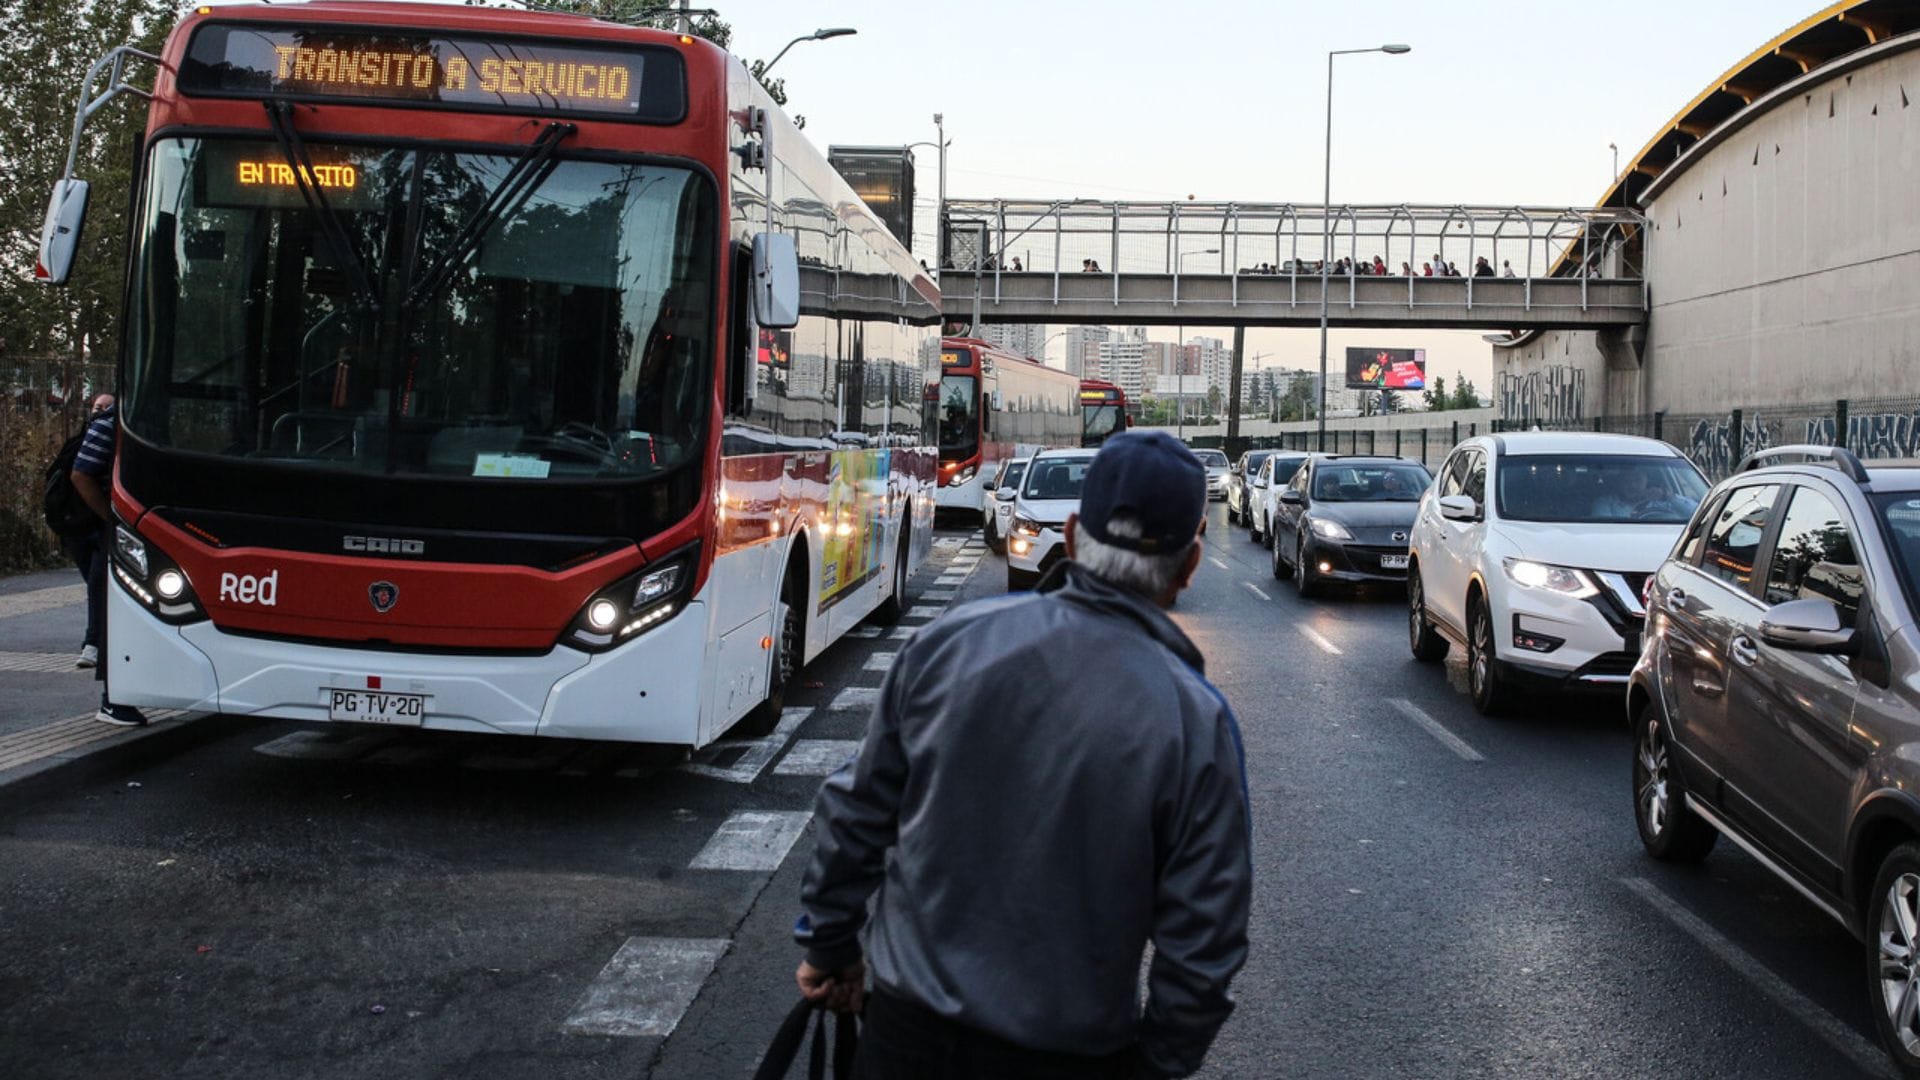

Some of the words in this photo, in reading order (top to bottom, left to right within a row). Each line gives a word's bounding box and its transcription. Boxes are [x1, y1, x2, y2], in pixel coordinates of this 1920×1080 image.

[275, 46, 434, 88] TRANSITO
[446, 57, 467, 90] A
[480, 59, 628, 99] SERVICIO
[240, 162, 263, 183] EN
[220, 569, 278, 606] Red
